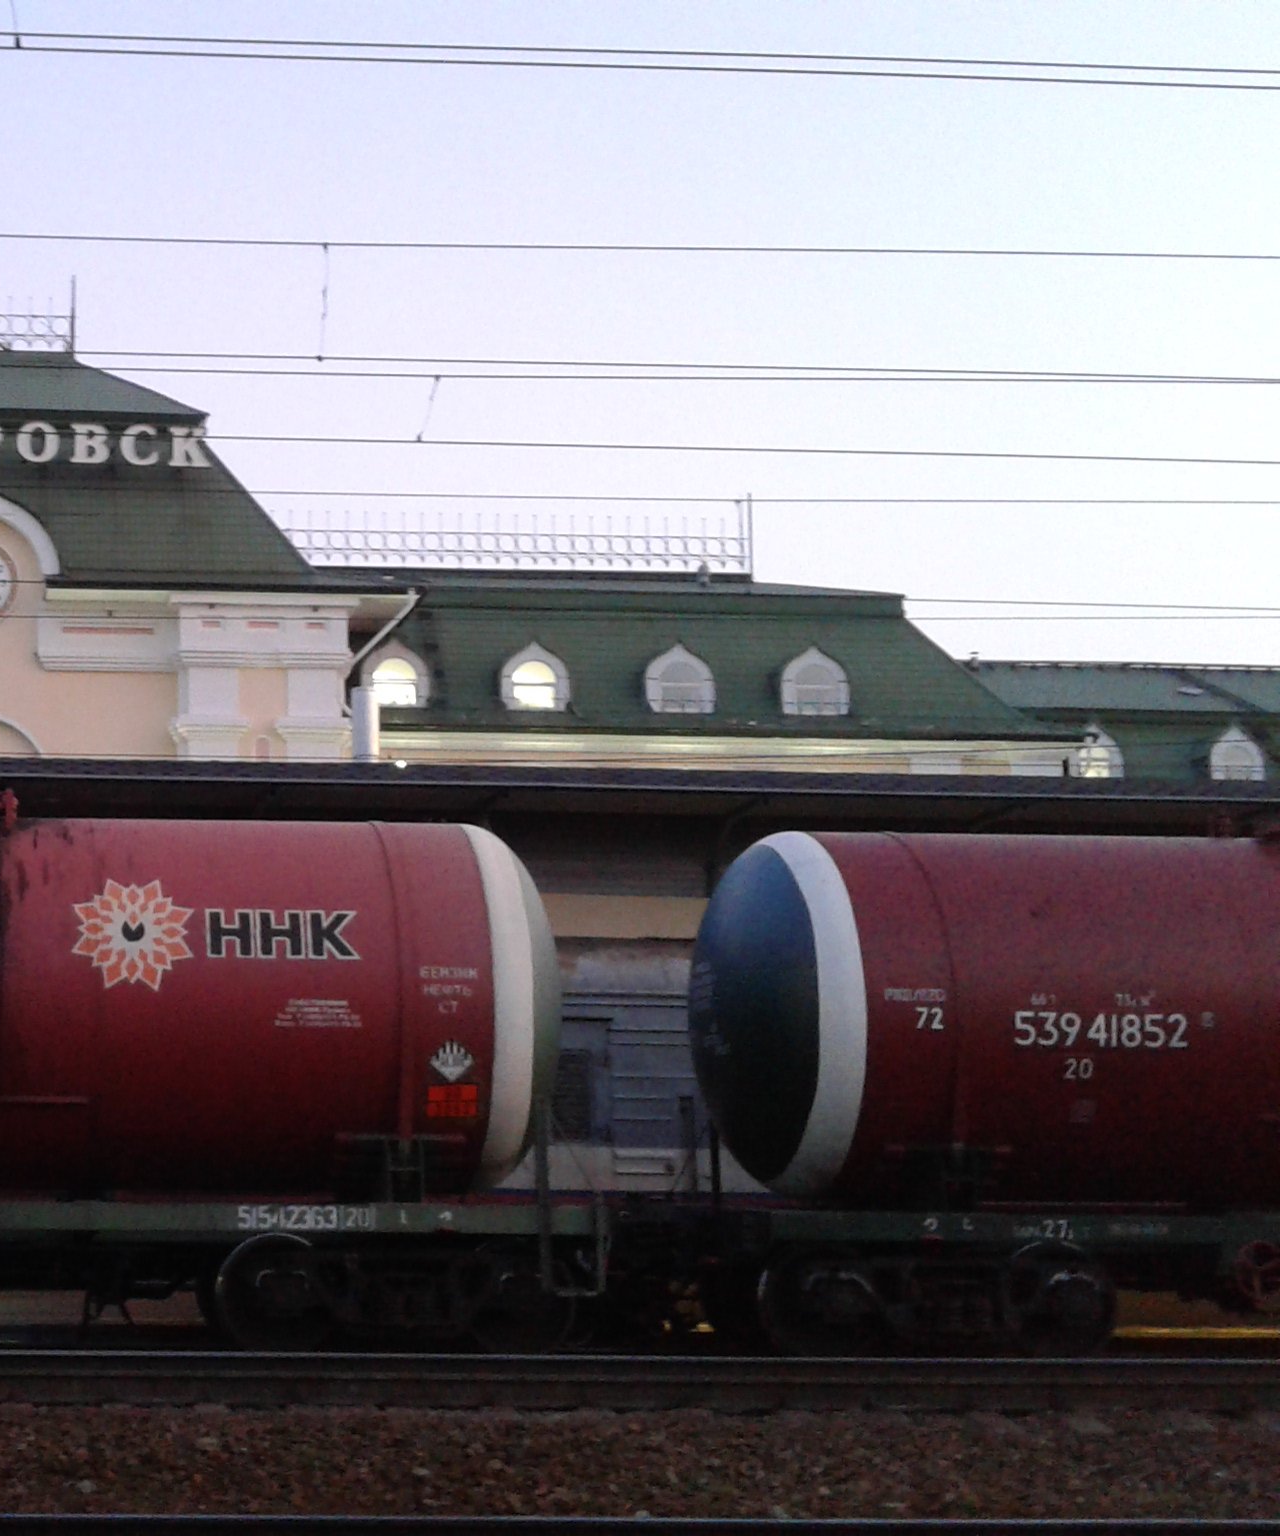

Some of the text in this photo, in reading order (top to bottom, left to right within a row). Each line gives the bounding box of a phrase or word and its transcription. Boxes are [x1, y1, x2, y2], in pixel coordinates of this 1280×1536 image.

[204, 908, 362, 961] ННК
[915, 1007, 945, 1031] 72
[1064, 1057, 1094, 1080] 20
